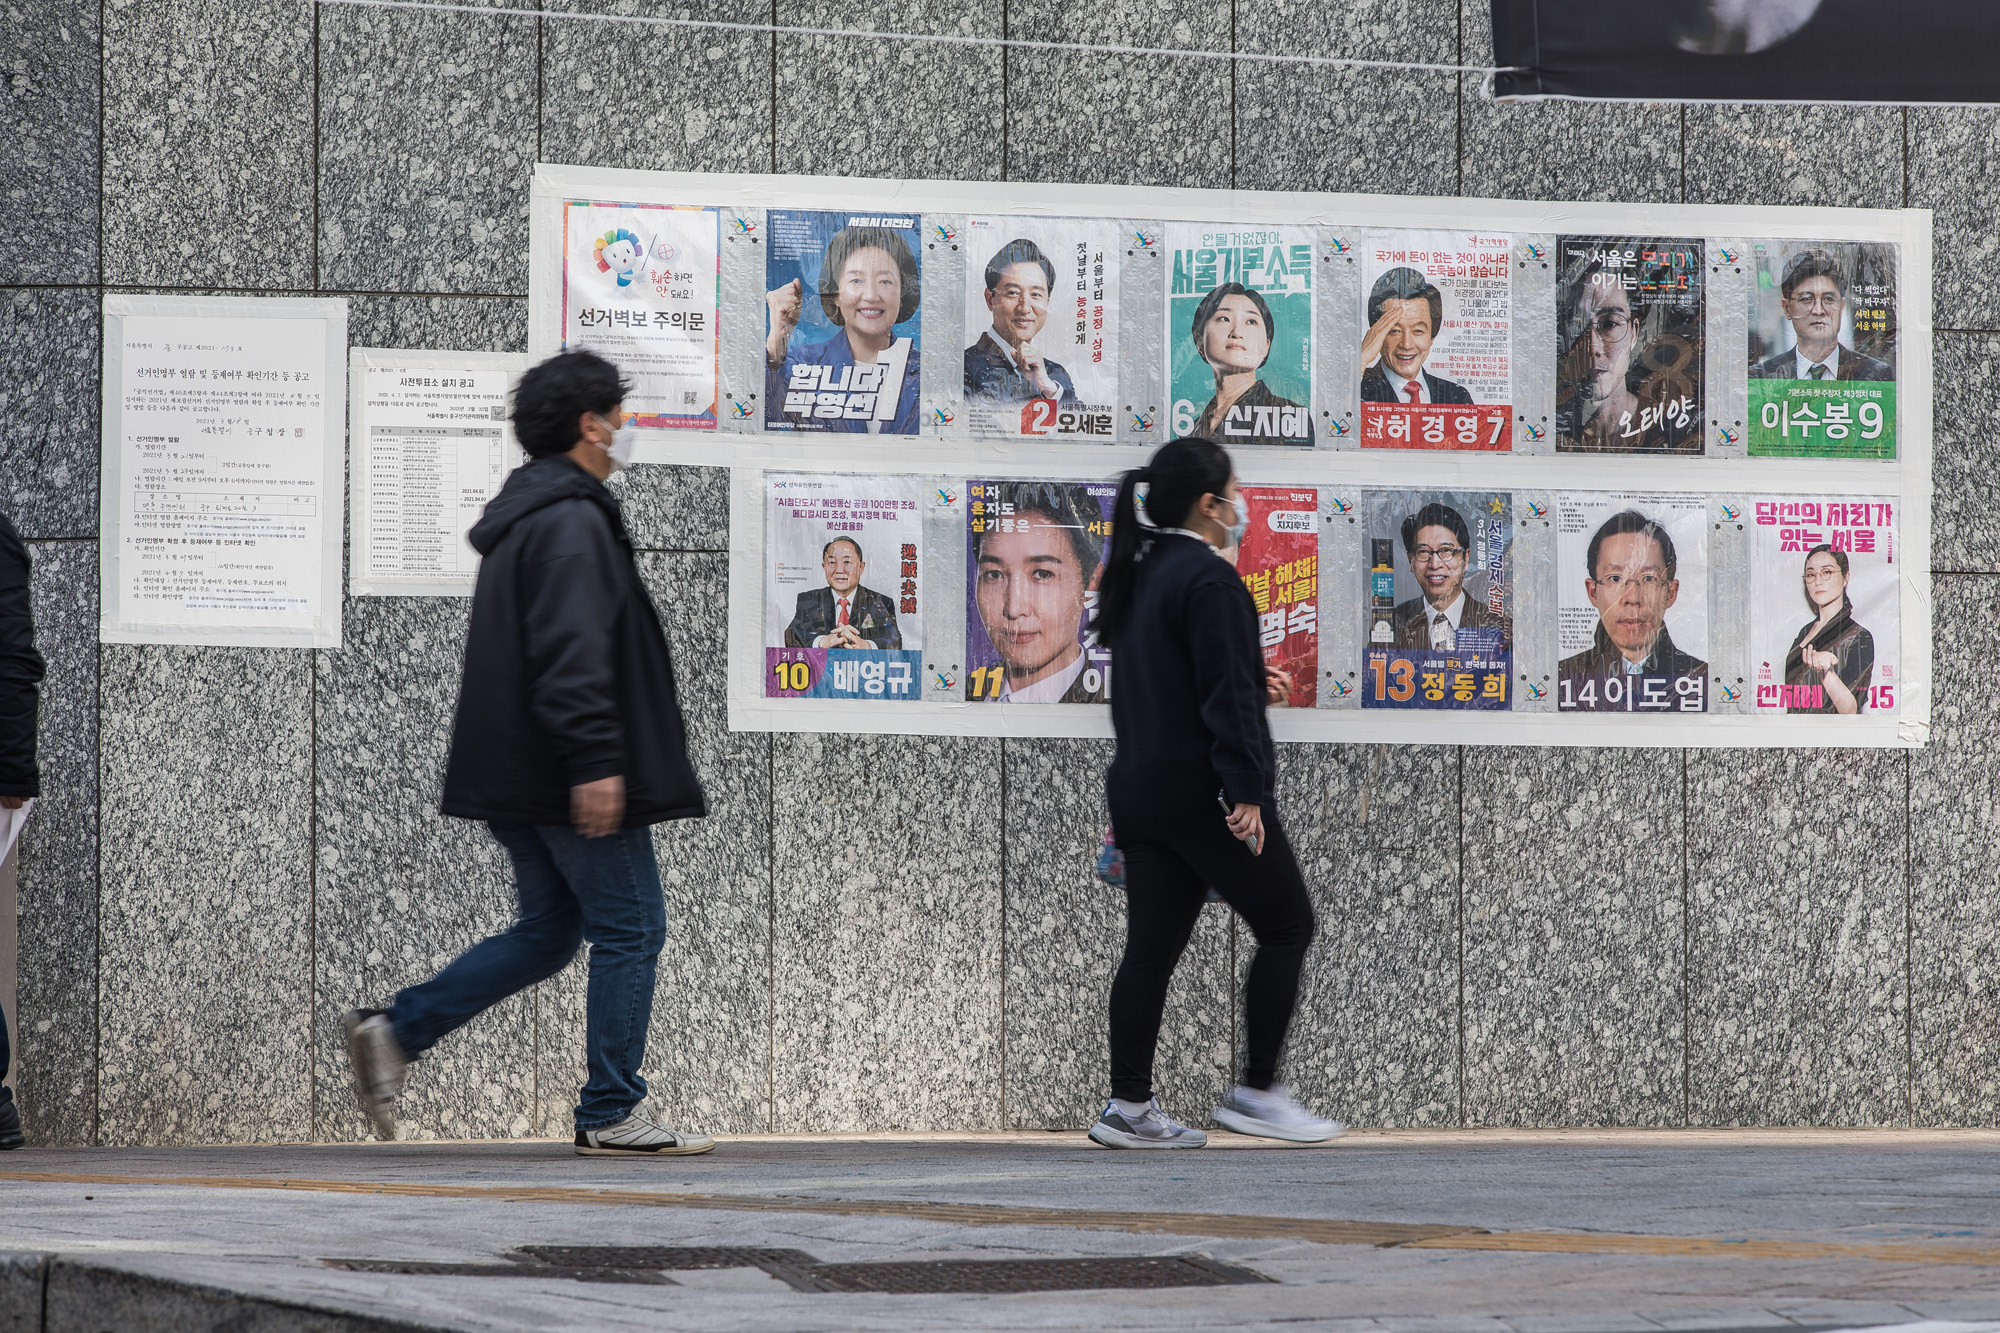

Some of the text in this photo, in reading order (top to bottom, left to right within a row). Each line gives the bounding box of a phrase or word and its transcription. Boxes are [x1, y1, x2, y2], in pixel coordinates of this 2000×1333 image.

[848, 217, 915, 229] 서울시 대전환
[1479, 238, 1509, 247] 국가혁명당
[1376, 250, 1509, 266] 국가에 돈이 없는 것이 아니라
[1591, 249, 1694, 270] 서울은 무지개
[650, 269, 693, 285] 훼손하면
[1093, 252, 1103, 301] 서울부터
[1171, 245, 1311, 294] 서울기본소득
[1426, 265, 1508, 278] 도둑놈이 많습니다
[1440, 279, 1508, 289] 국가 미래를 내다보는
[1591, 272, 1638, 290] 이기는
[656, 286, 694, 300] 안 돼요!
[1075, 241, 1087, 345] 첫날부터 능숙하게
[1454, 289, 1483, 298] 허경영이
[1458, 299, 1508, 309] 그 나물에 그 밥
[578, 308, 705, 331] 선거벽보 주의문
[1460, 309, 1475, 318] 이제
[1855, 309, 1887, 320] 서민 행복
[1442, 320, 1462, 329] 서울시
[1463, 320, 1477, 329] 예산
[1479, 321, 1492, 329] 70%
[1855, 321, 1886, 331] 서울 혁명
[136, 367, 310, 382] 선거인명부 열람 및 등재여부 확인기간 등 공고
[400, 377, 475, 388] 사전투표소 설치 공고
[783, 391, 877, 420] 박영선
[876, 337, 913, 421] 1
[788, 363, 884, 392] 합니다
[1787, 388, 1812, 397] 기본소득
[1813, 388, 1821, 398] 첫
[1843, 389, 1868, 399] 제3정치
[1869, 389, 1883, 398] 대표
[1032, 401, 1055, 432] 2
[1060, 403, 1112, 413] 서울특별시장후보
[1057, 413, 1112, 435] 오세훈
[1172, 398, 1308, 438] 6 신지혜
[1618, 394, 1696, 438] 오태양
[1761, 400, 1884, 439] 이수봉 9
[1387, 414, 1506, 445] 허경영 7
[970, 484, 1001, 499] 여자
[1087, 487, 1117, 497] 여성의당
[1290, 493, 1313, 502] 진보당
[821, 498, 851, 509] 에덴동산
[853, 499, 868, 509] 공원
[870, 499, 899, 509] 100만평
[900, 500, 918, 511] 조성,
[970, 501, 1016, 516] 혼자도
[792, 509, 899, 521] 메디컬시티 조성, 복지정책 확대,
[1755, 502, 1893, 527] 당신의 자리가
[826, 521, 864, 531] 예산효율화
[970, 518, 1115, 536] 살기좋은 서울
[1276, 520, 1310, 530] 지지후보
[1487, 519, 1503, 551] 서울
[1780, 528, 1876, 553] 있는 서울
[1275, 555, 1317, 586] 해체!
[1275, 576, 1317, 606] 서울!
[781, 652, 805, 661] 기호
[774, 660, 913, 694] 10 배영규
[970, 666, 1005, 698] 11
[1369, 659, 1416, 702] 13
[1421, 672, 1506, 702] 정동희
[1559, 675, 1704, 712] 14 이도엽
[1756, 684, 1894, 709] 신지예 15
